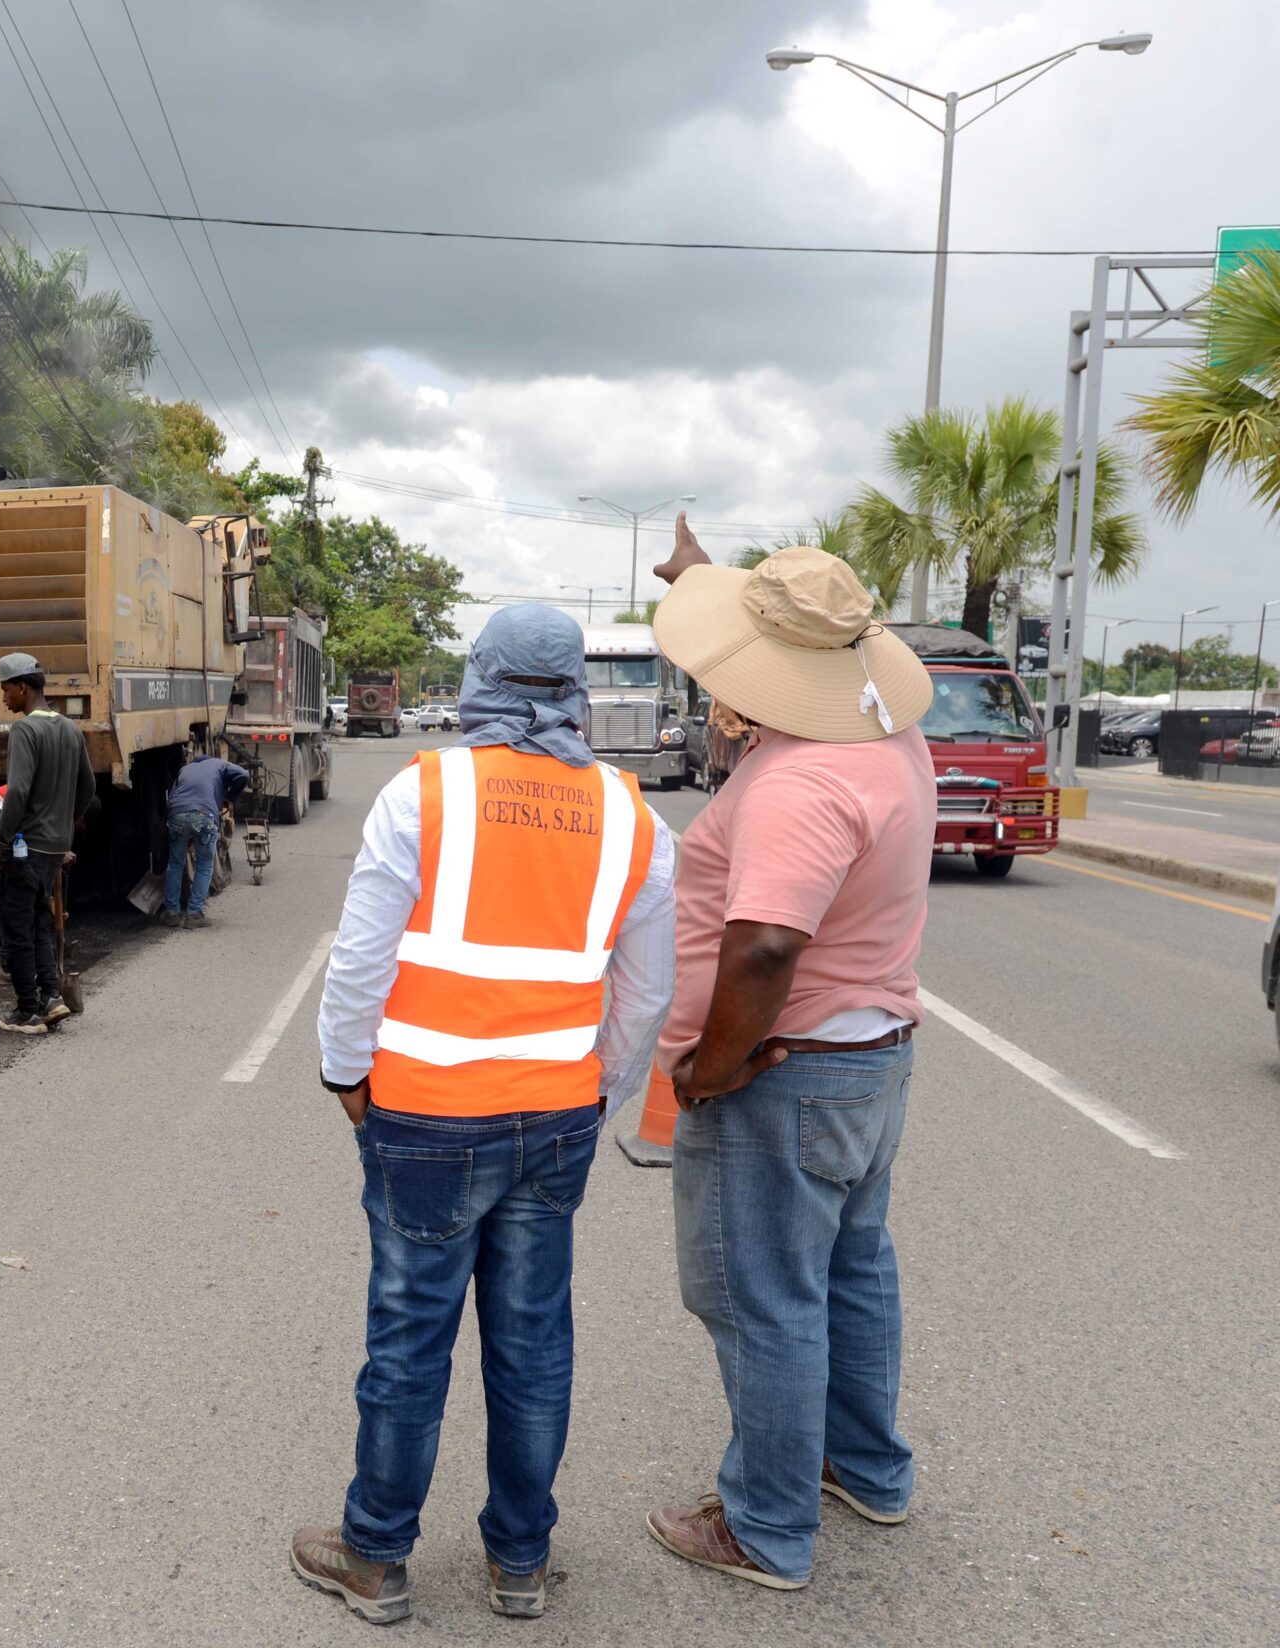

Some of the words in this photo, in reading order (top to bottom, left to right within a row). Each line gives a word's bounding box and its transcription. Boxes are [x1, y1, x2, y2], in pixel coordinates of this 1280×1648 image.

[486, 777, 594, 807] CONSTRUCTORA
[483, 800, 548, 834] CETSA,
[552, 808, 599, 836] S.R.L
